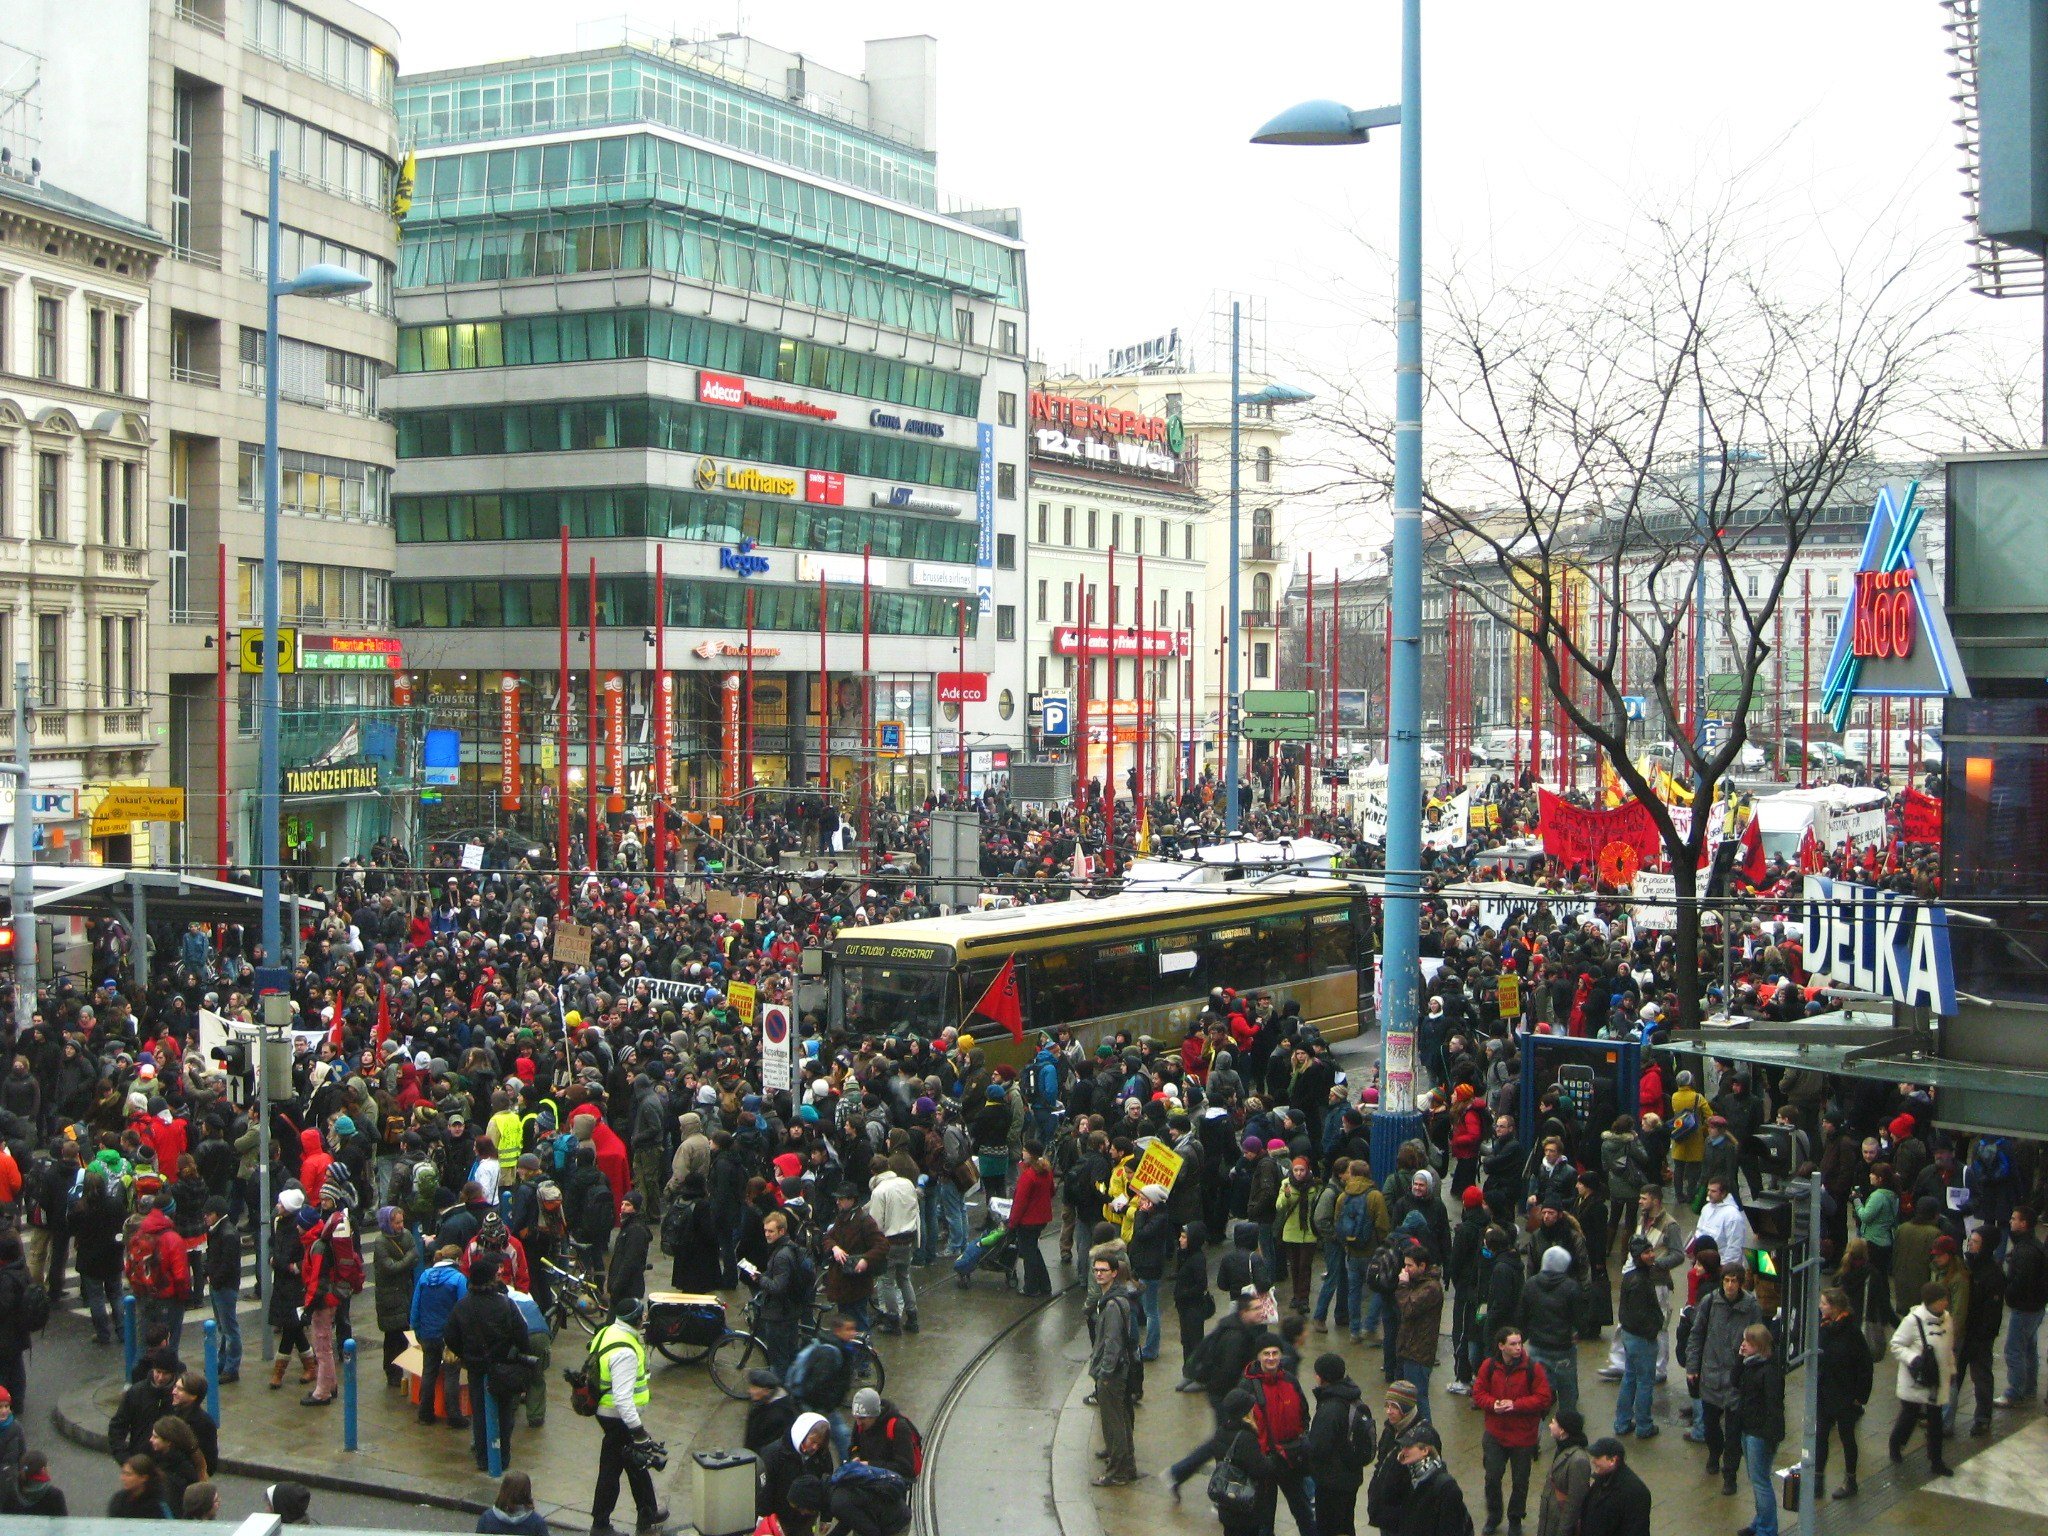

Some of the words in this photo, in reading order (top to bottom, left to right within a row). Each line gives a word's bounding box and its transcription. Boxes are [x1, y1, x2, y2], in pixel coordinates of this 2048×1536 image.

[703, 380, 741, 402] Adecco
[1036, 428, 1082, 457] 12x
[1085, 437, 1110, 461] in
[726, 464, 797, 496] Lufthansa
[809, 472, 826, 484] swiss
[889, 486, 913, 506] LOT
[719, 547, 770, 577] Regus
[922, 569, 948, 583] brussels
[949, 572, 971, 585] airlines
[1853, 569, 1913, 658] KÖÖ
[940, 687, 981, 699] Adecco
[503, 695, 512, 734] LESEN
[543, 713, 578, 726] PRIS
[664, 696, 672, 735] LESEN
[1046, 707, 1064, 732] P
[613, 696, 623, 795] BUCHLANDUNG
[503, 737, 512, 794] GÜNSTIG
[286, 766, 378, 793] TAUSCHZENTRALE
[32, 794, 71, 812] UPC
[114, 796, 142, 804] Ankauf
[149, 796, 178, 805] Verkauf
[1488, 898, 1590, 916] FINANZPRITZE
[845, 944, 859, 955] CUT
[1802, 875, 1944, 1015] DELKA
[624, 978, 702, 1004] BRNING
[1141, 1160, 1172, 1187] SOLLEN
